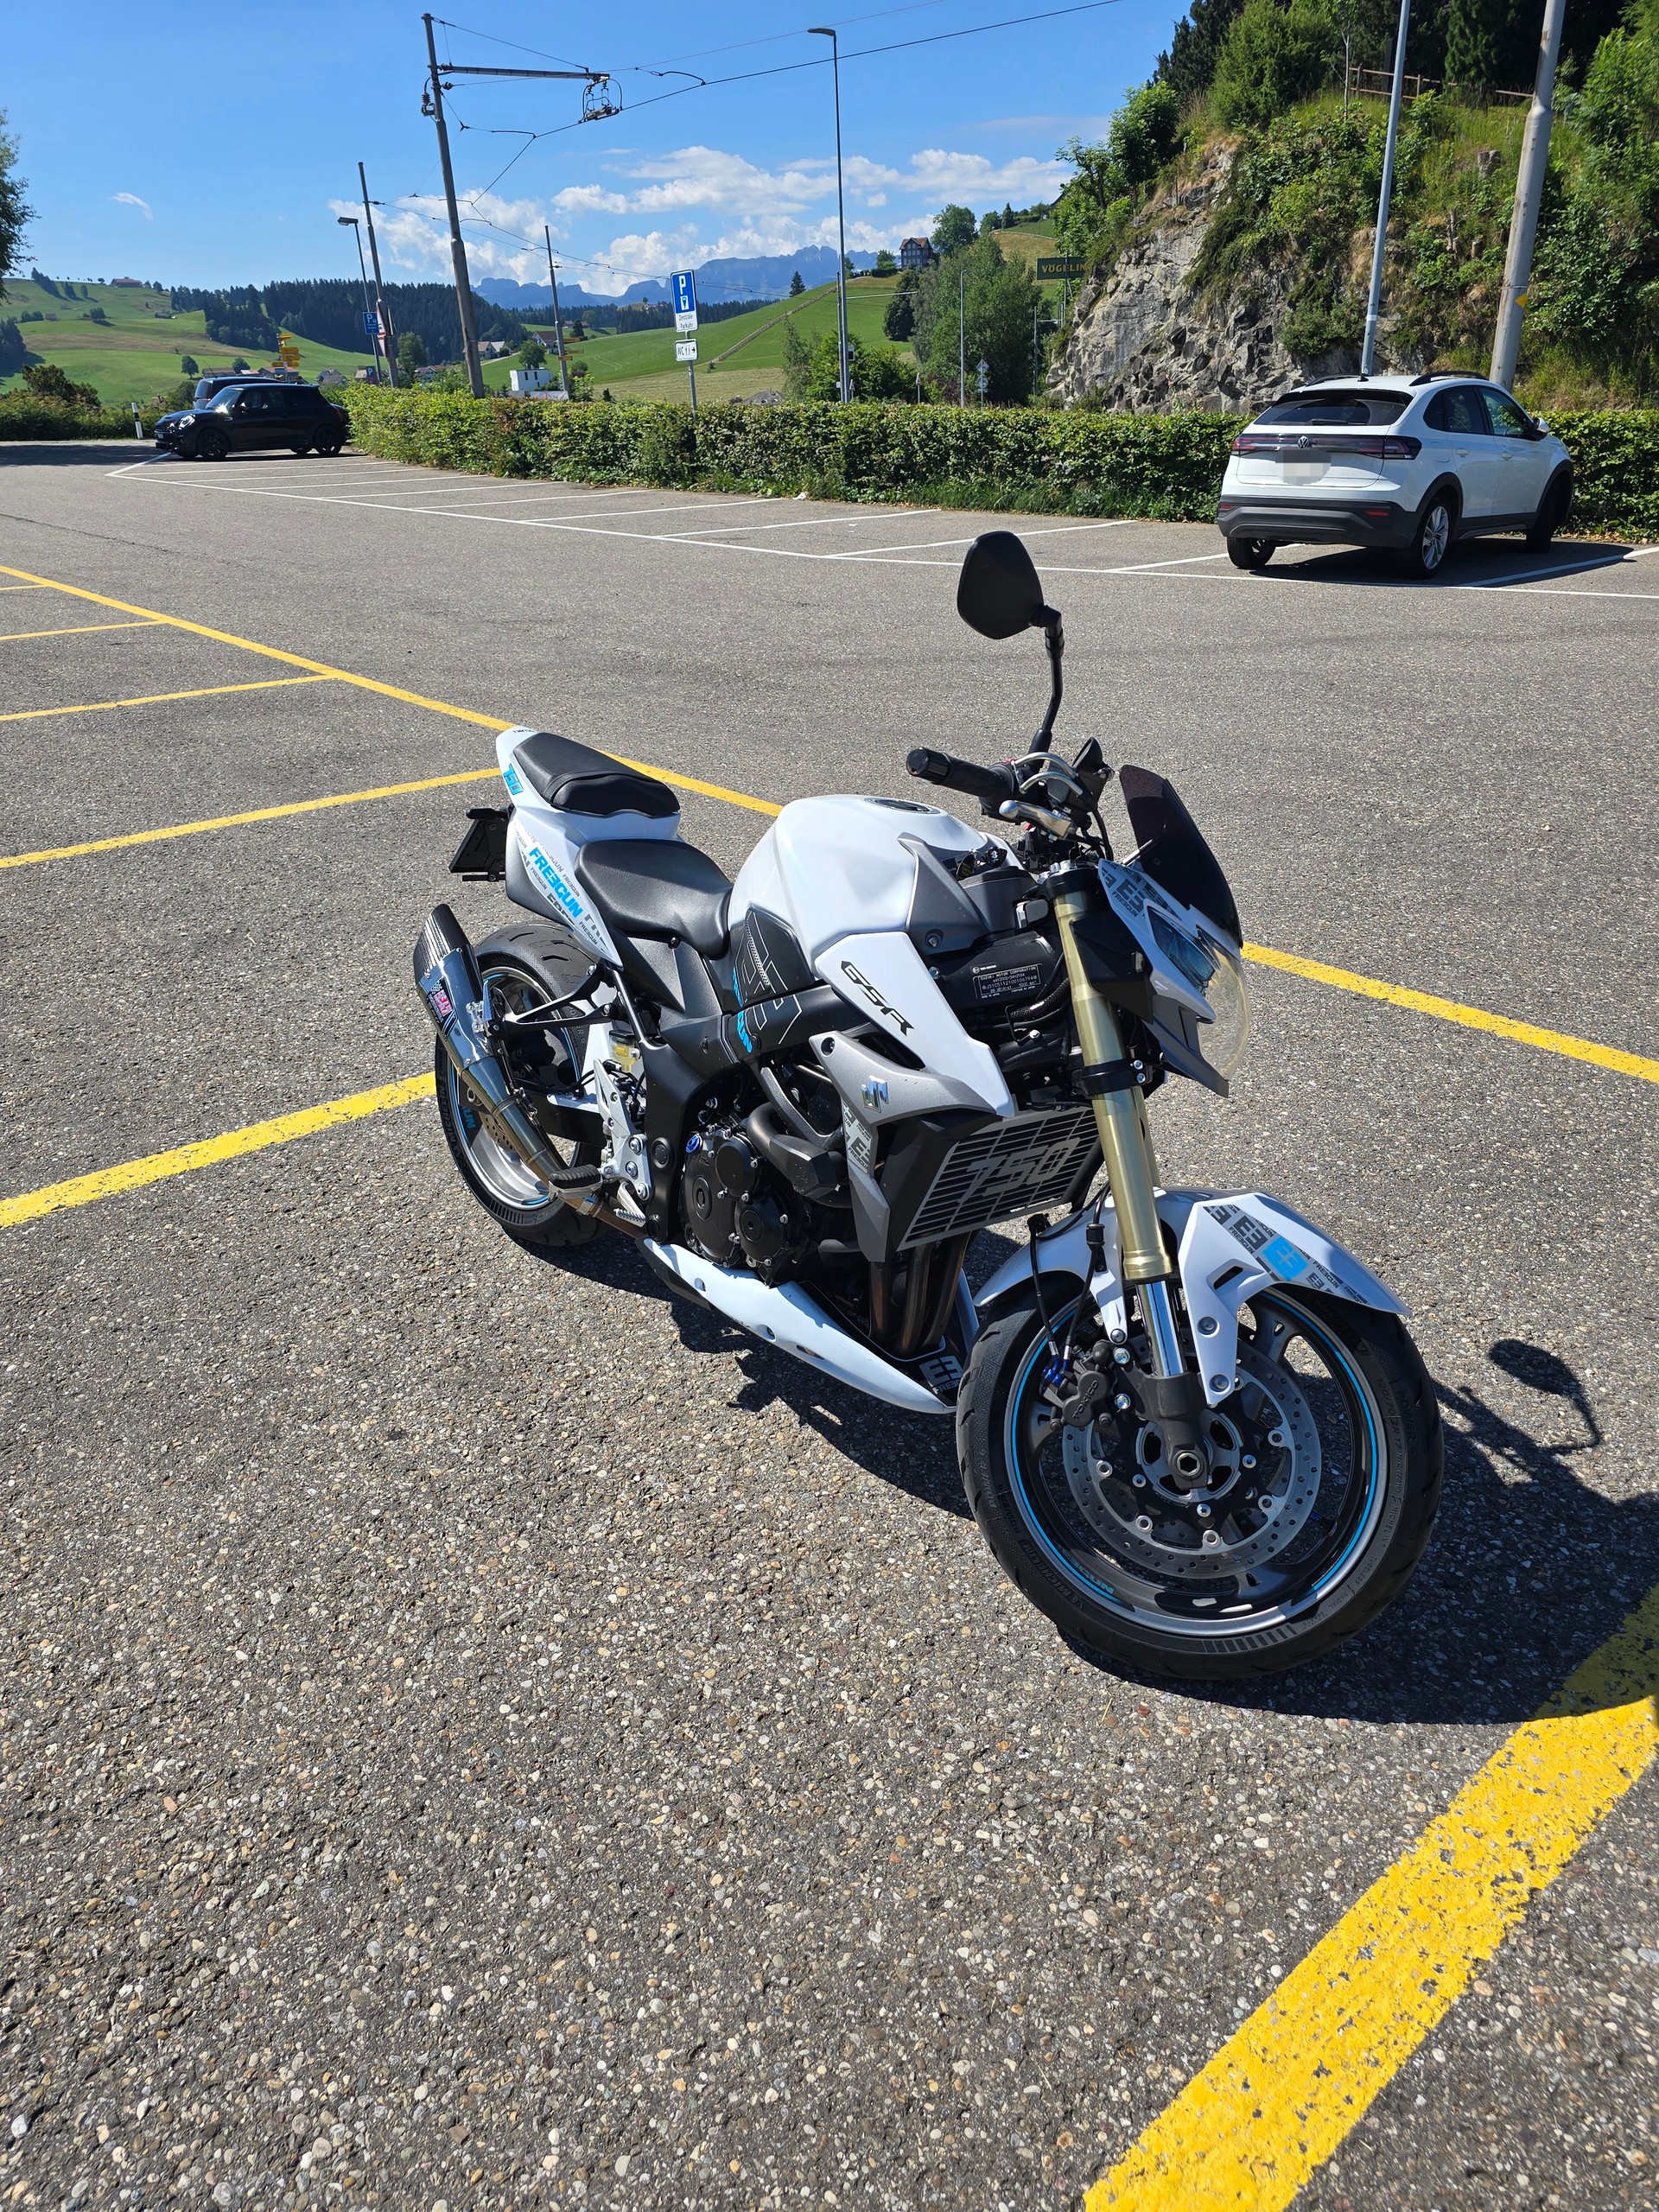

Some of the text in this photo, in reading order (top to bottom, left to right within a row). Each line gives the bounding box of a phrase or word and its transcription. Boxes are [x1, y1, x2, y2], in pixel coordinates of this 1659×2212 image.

[678, 276, 687, 295] P
[529, 847, 583, 918] FREEGUN
[841, 960, 915, 1036] GSR
[966, 1137, 1080, 1203] 750
[1229, 1226, 1255, 1255] FREEGUN
[1313, 1260, 1340, 1289] FREEGUN
